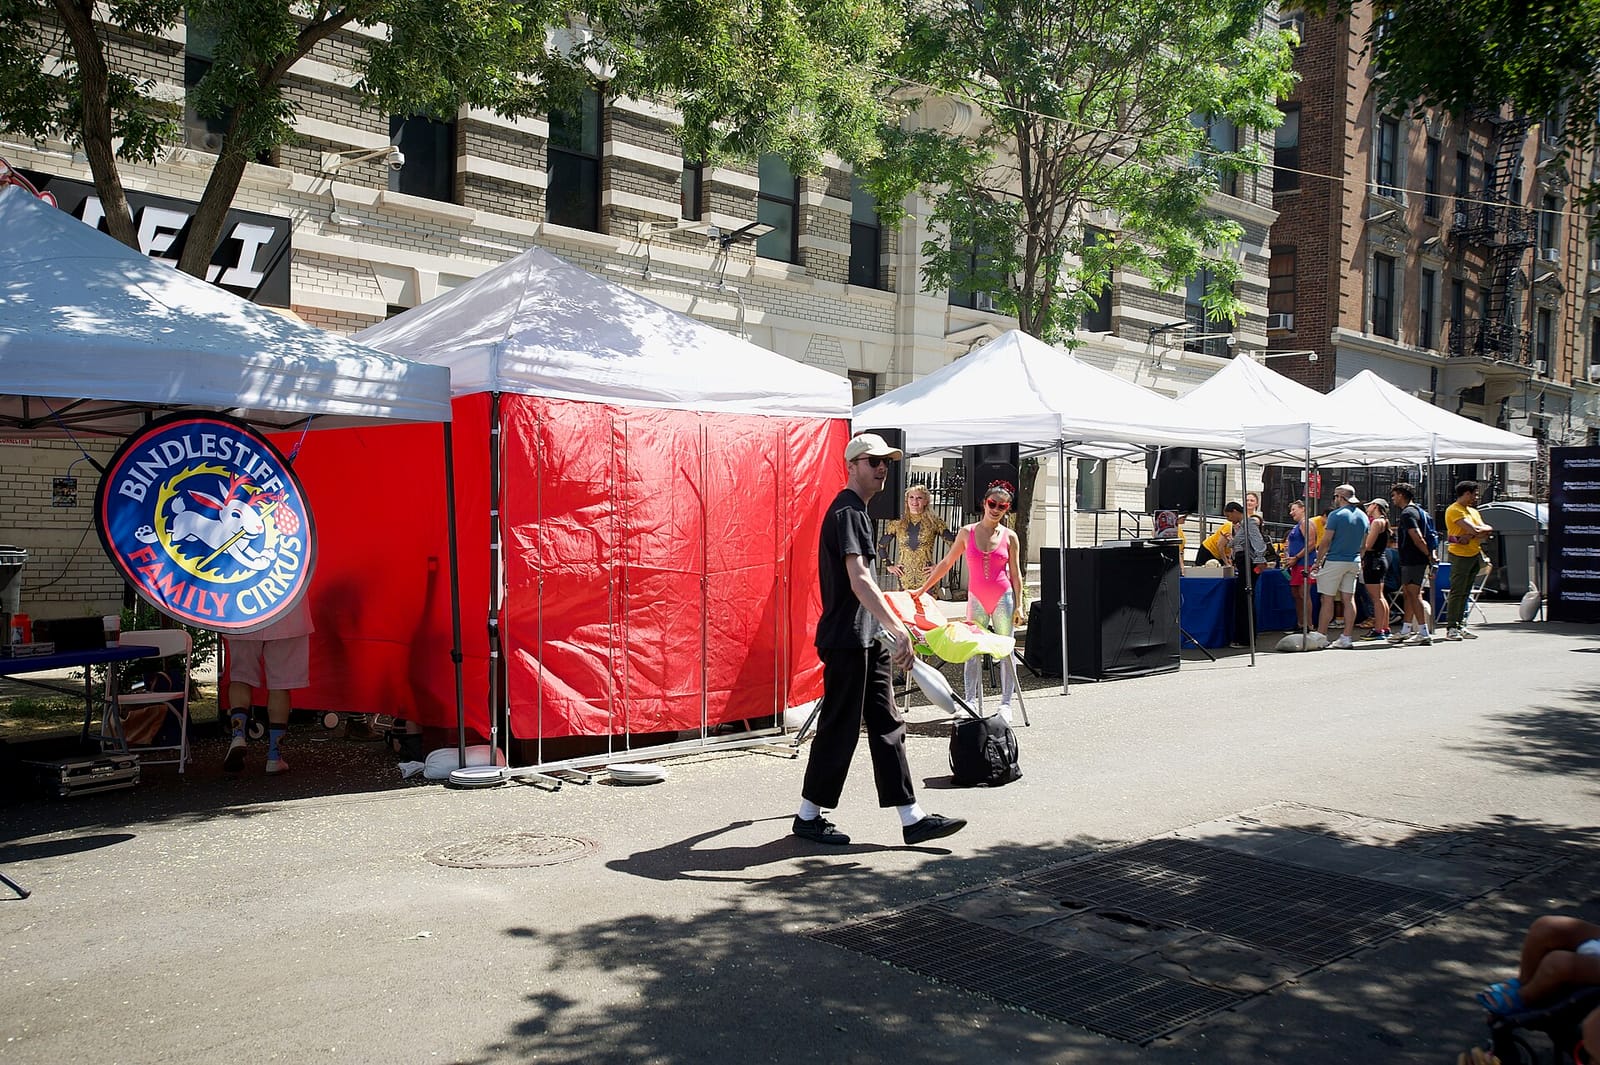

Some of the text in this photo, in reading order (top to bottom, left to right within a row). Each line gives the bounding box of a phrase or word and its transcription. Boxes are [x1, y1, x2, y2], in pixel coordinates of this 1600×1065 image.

[82, 196, 275, 288] EI
[118, 433, 284, 503] BINDLESTIFF
[127, 536, 301, 618] FAMILY CIRKUS
